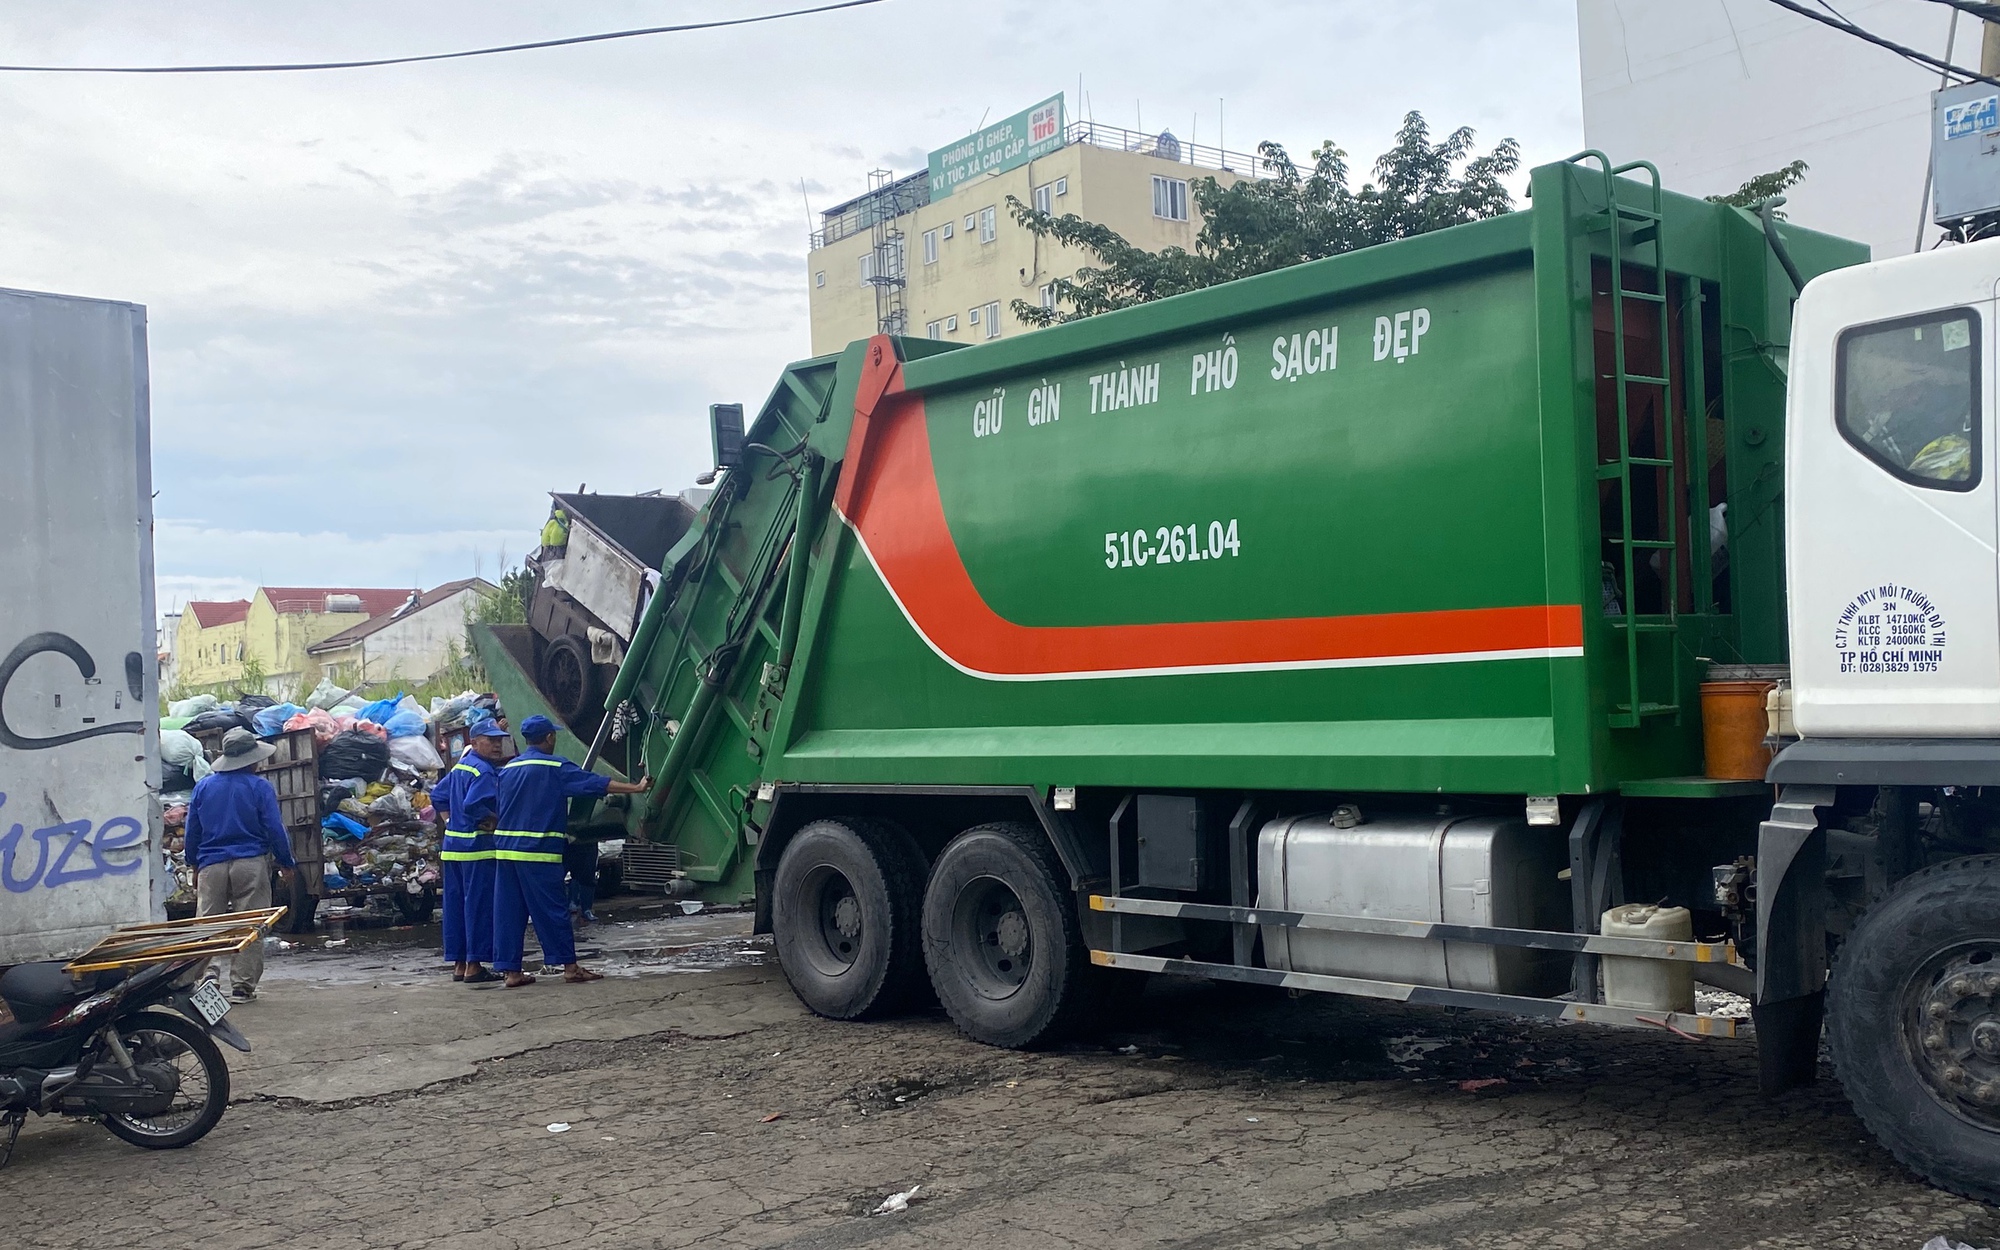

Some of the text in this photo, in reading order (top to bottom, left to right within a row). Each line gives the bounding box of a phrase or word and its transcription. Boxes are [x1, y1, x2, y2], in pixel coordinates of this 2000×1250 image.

[1032, 117, 1055, 141] 1tr6
[942, 141, 975, 168] PHÒNG
[986, 124, 1014, 148] GHÉP,
[982, 148, 1002, 168] CAO
[1004, 135, 1025, 159] CẤP
[972, 307, 1431, 438] GIỮ GÌN THÀNH PHỐ SẠCH ĐẸP
[1104, 518, 1241, 569] 51C-261.04
[1857, 588, 1877, 606] MTV
[1879, 582, 1898, 598] MÔI
[1839, 602, 1860, 626] TNHH
[1882, 602, 1897, 611] 3N
[1858, 614, 1926, 625] KLBT 14710KG
[1835, 627, 1848, 649] C.TY
[1858, 624, 1926, 635] KLCC 9160KG
[1858, 635, 1926, 646] KLTB 24000KG
[1930, 631, 1946, 647] THỊ
[1840, 646, 1943, 663] TP HỒ CHÍ MINH
[1840, 662, 1938, 674] ĐT: (028)3829 1975
[205, 997, 227, 1022] 6207
